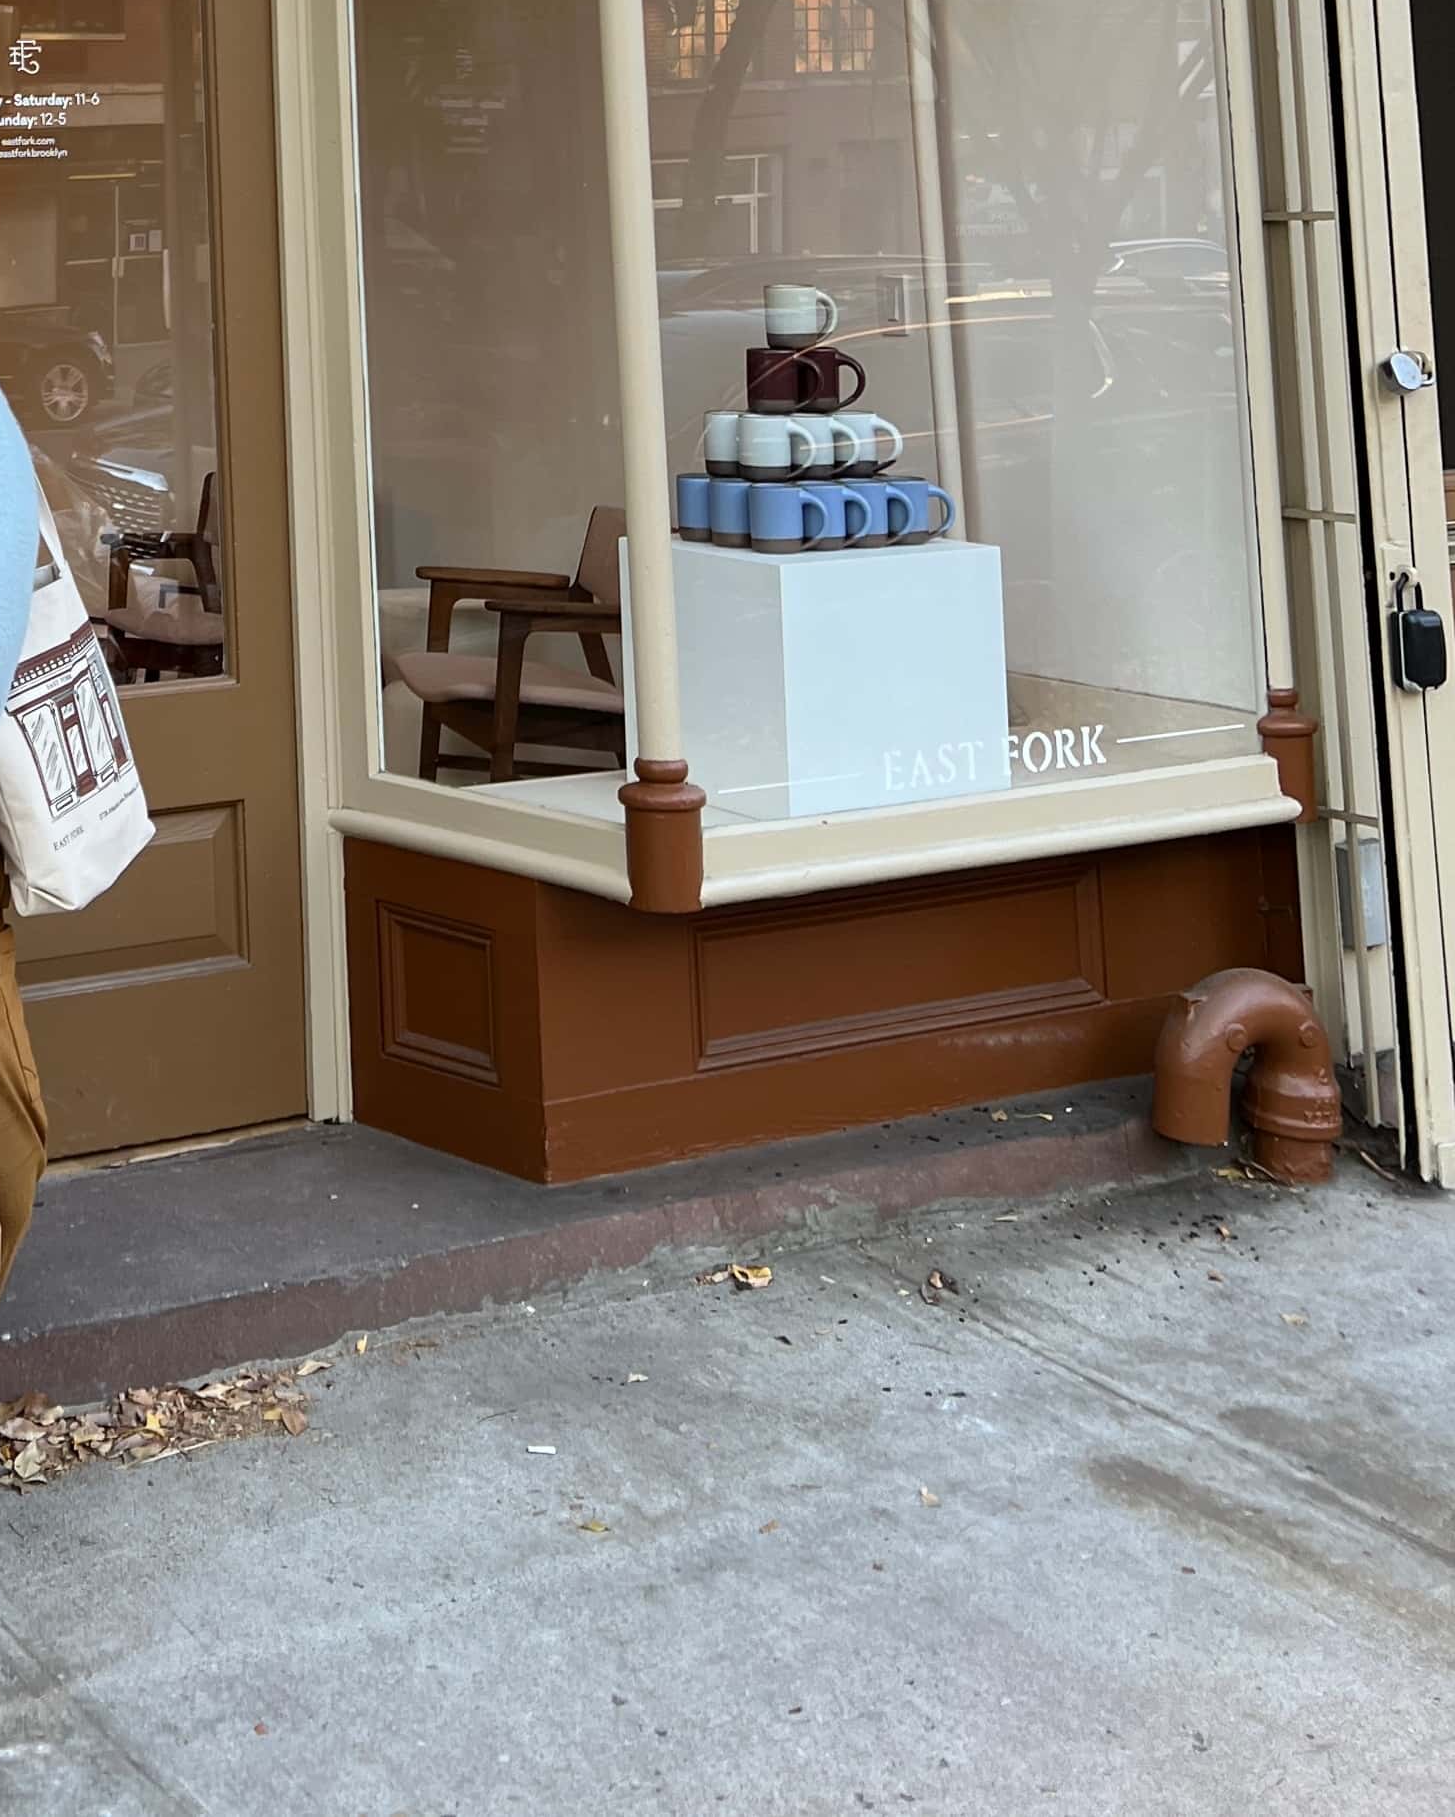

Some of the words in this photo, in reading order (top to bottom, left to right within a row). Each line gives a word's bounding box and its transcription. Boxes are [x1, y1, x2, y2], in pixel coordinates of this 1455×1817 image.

[14, 93, 72, 109] Saturday:
[75, 93, 100, 105] 11-6
[40, 112, 66, 126] 12-5
[1, 135, 55, 146] eastfork.com
[883, 739, 985, 791] EAST
[1000, 724, 1106, 776] FORK
